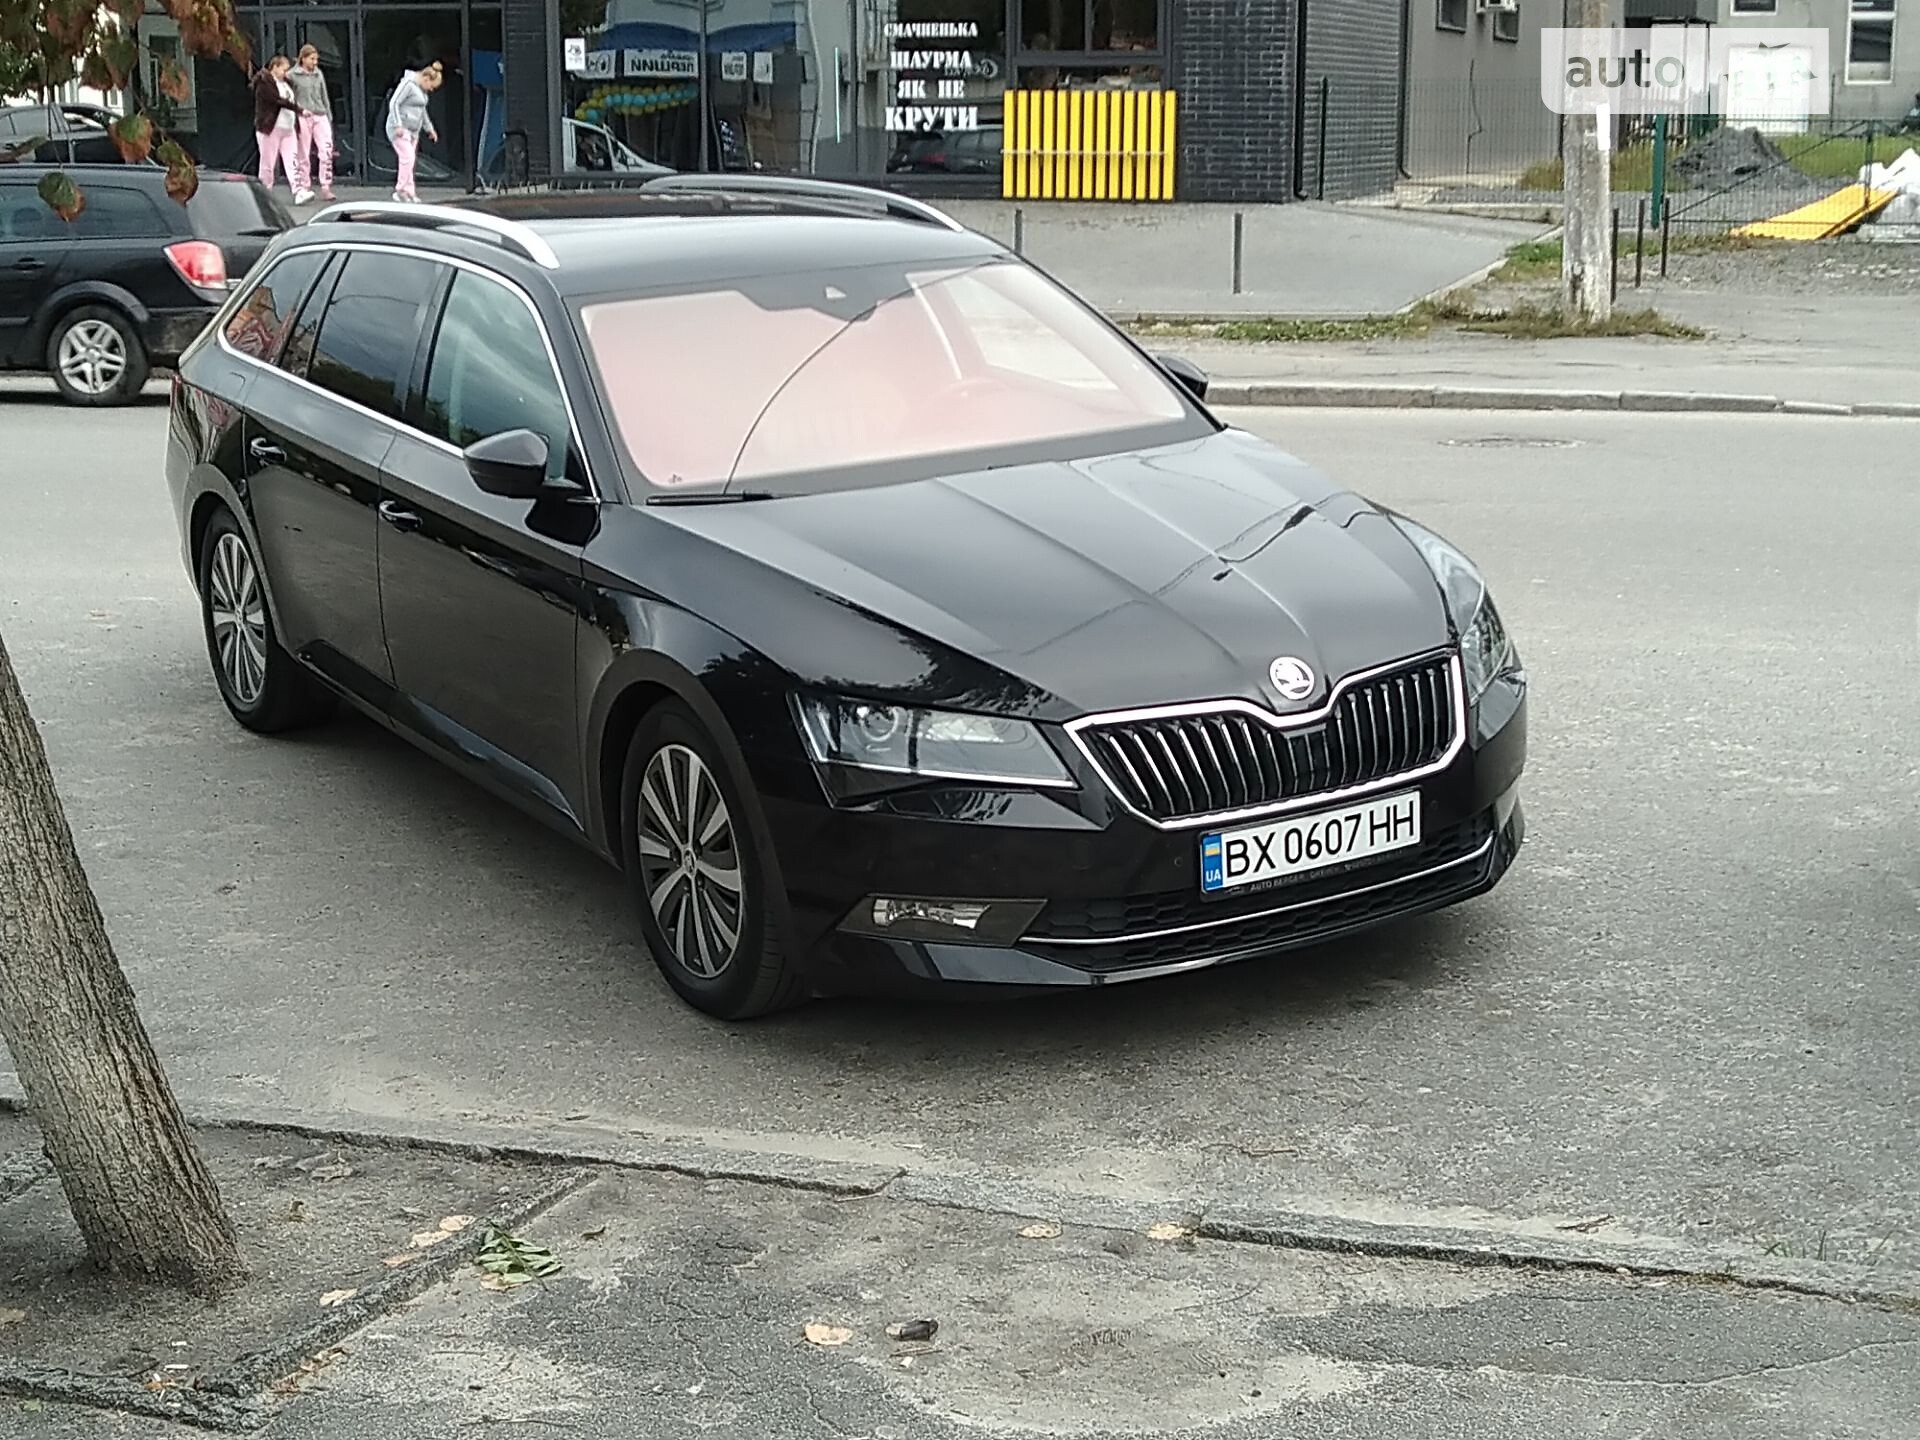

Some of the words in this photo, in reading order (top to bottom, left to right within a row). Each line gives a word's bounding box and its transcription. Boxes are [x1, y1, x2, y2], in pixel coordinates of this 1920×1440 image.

[883, 22, 979, 37] СМАЧНЕНЬКА
[890, 50, 972, 69] ШАУРМА
[897, 79, 927, 99] ЯК
[937, 79, 965, 99] НЕ
[884, 106, 978, 132] КРУТИ
[1225, 831, 1277, 879] BX
[1284, 813, 1362, 865] 0607
[1369, 800, 1415, 848] HH
[1205, 868, 1222, 884] UA
